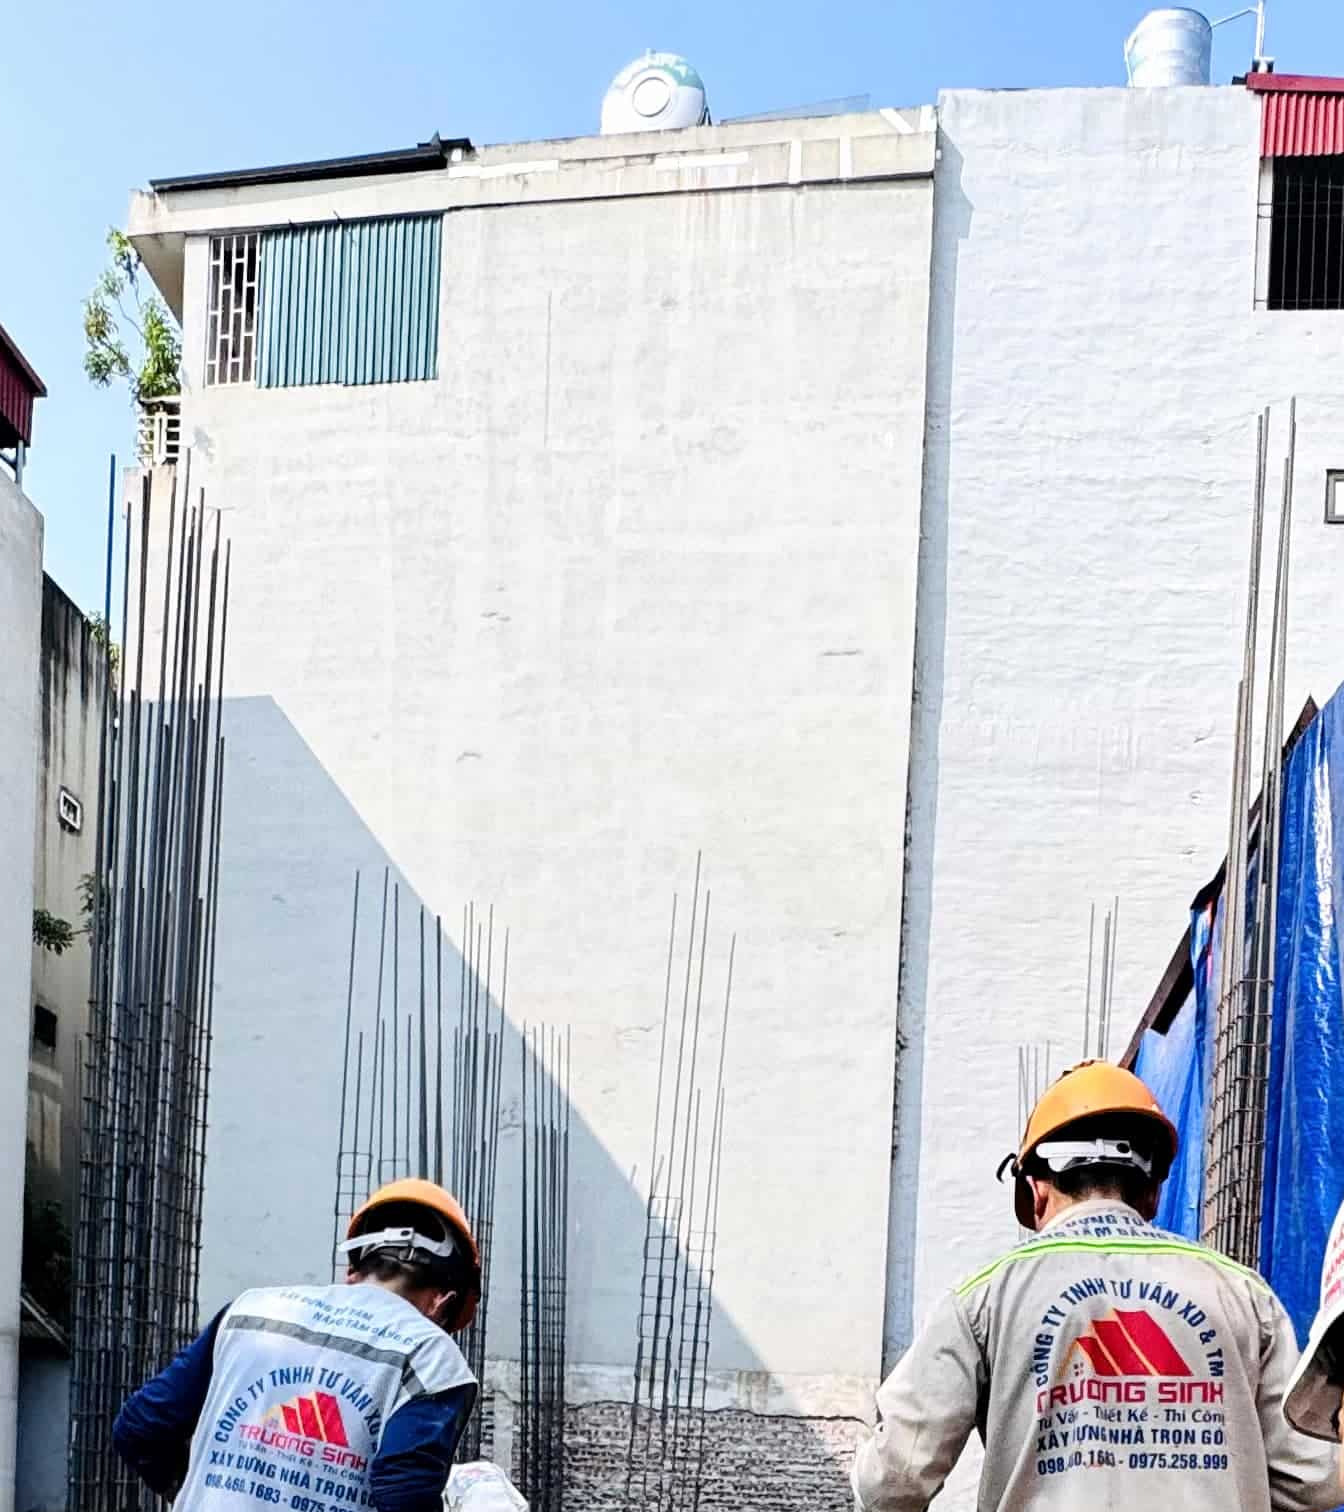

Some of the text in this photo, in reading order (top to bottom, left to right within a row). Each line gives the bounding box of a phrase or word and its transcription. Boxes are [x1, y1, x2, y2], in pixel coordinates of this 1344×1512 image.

[1060, 1278, 1106, 1305] TNHH
[1110, 1279, 1133, 1299] TƯ
[1042, 1305, 1066, 1327] TY
[1178, 1301, 1206, 1327] XD
[1200, 1330, 1216, 1344] &
[1207, 1348, 1224, 1377] TM
[248, 1378, 265, 1399] TY
[269, 1365, 314, 1387] TNHH
[1158, 1382, 1223, 1404] SINH
[1164, 1408, 1186, 1422] Thi
[1109, 1426, 1144, 1445] NHÀ
[1151, 1429, 1195, 1448] TRỌN
[321, 1447, 368, 1472] SINH
[1129, 1454, 1228, 1469] 0975.258.999
